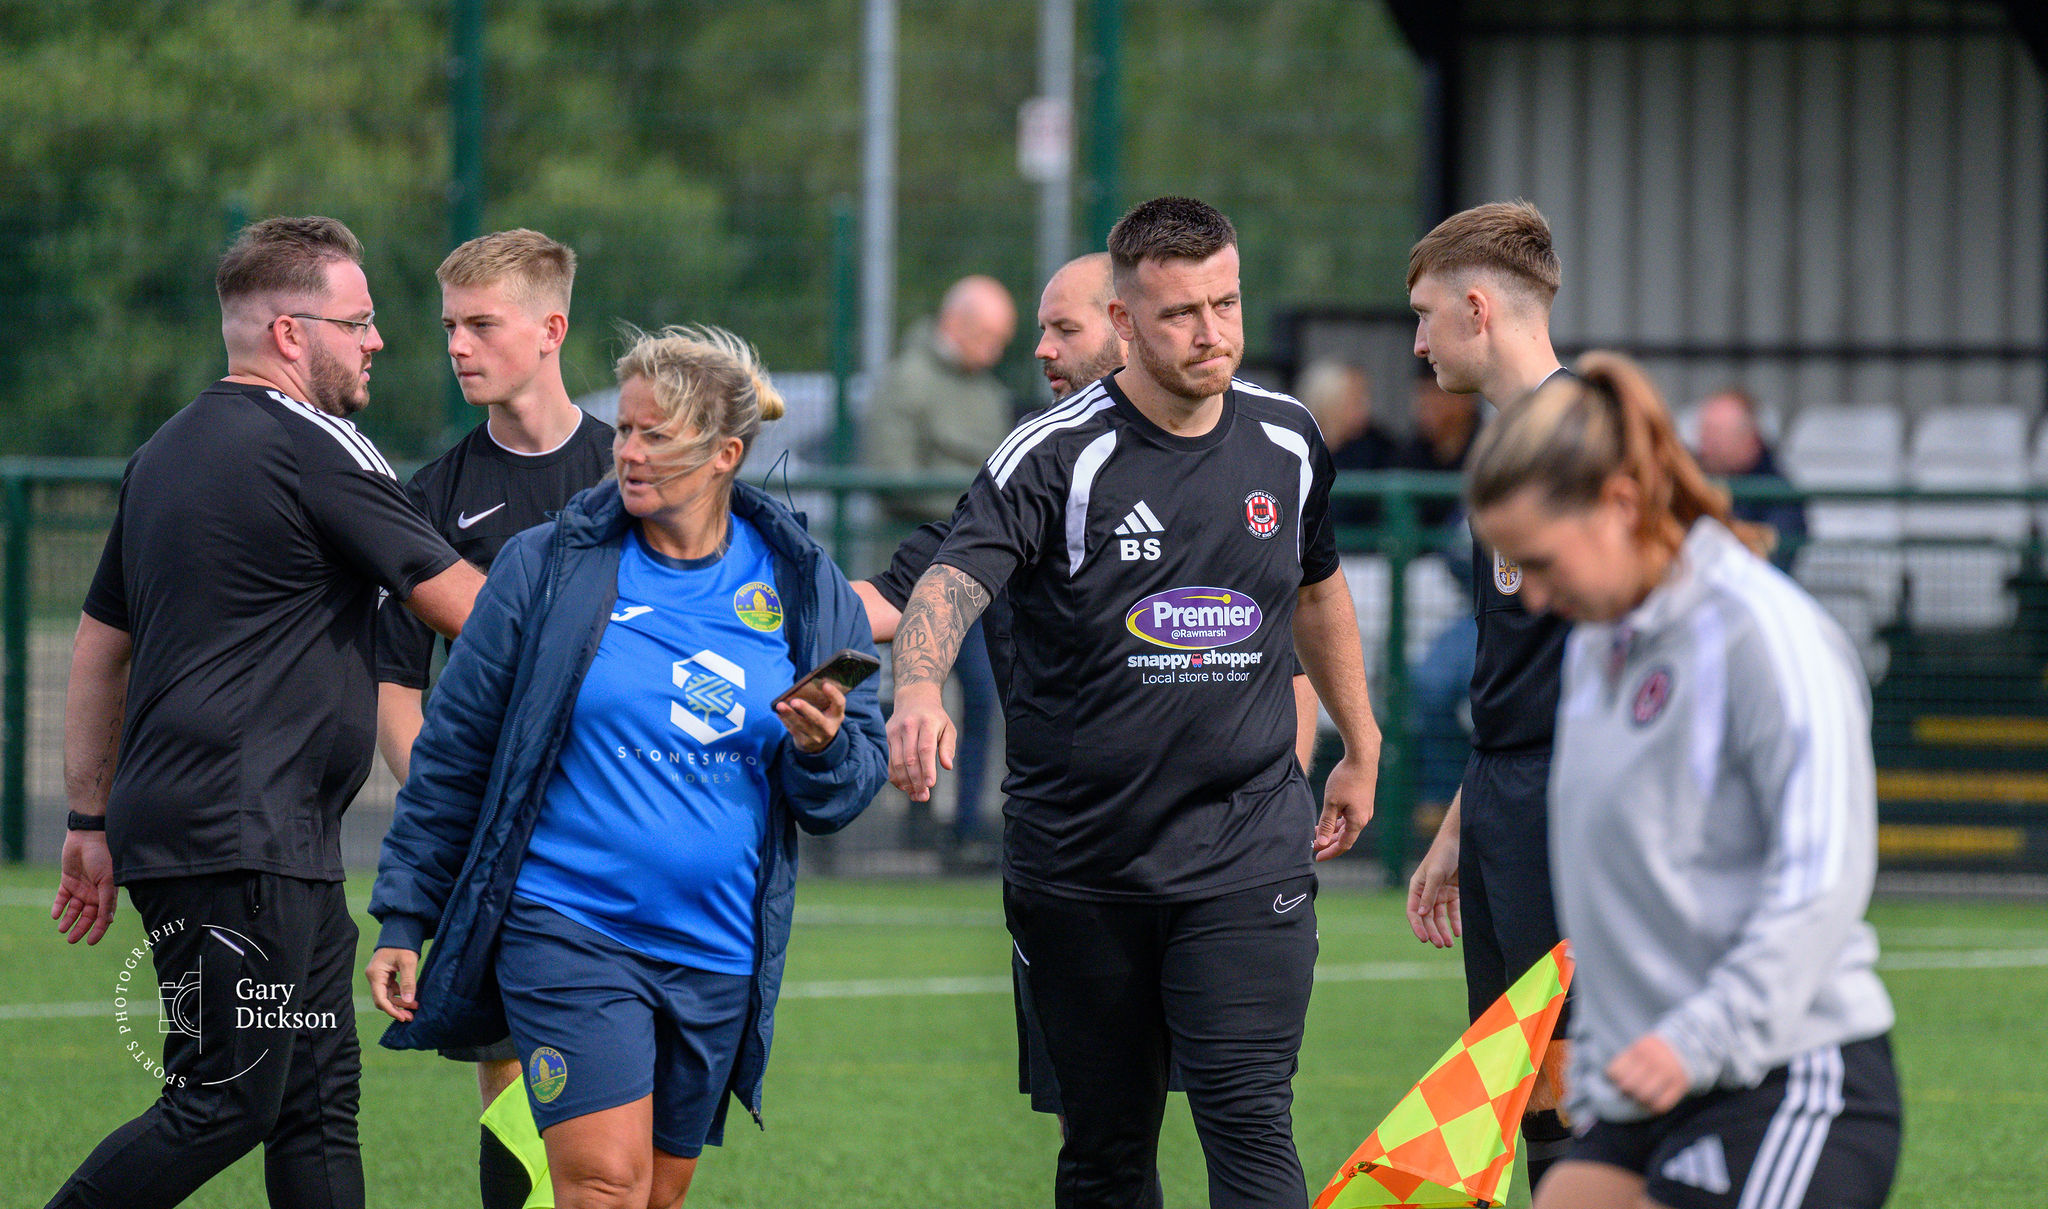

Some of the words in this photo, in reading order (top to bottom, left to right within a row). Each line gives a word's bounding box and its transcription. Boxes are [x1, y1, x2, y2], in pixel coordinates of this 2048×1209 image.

[1120, 538, 1161, 561] BS
[1152, 600, 1255, 628] Premier
[1171, 628, 1226, 640] @Rawmarsh
[1127, 653, 1192, 670] snappy
[1202, 650, 1263, 668] shopper
[1142, 672, 1175, 684] Local
[1178, 673, 1209, 683] store
[1212, 672, 1224, 682] to
[1226, 671, 1250, 682] door
[617, 746, 757, 765] STONESWOO
[671, 771, 731, 784] HOMES
